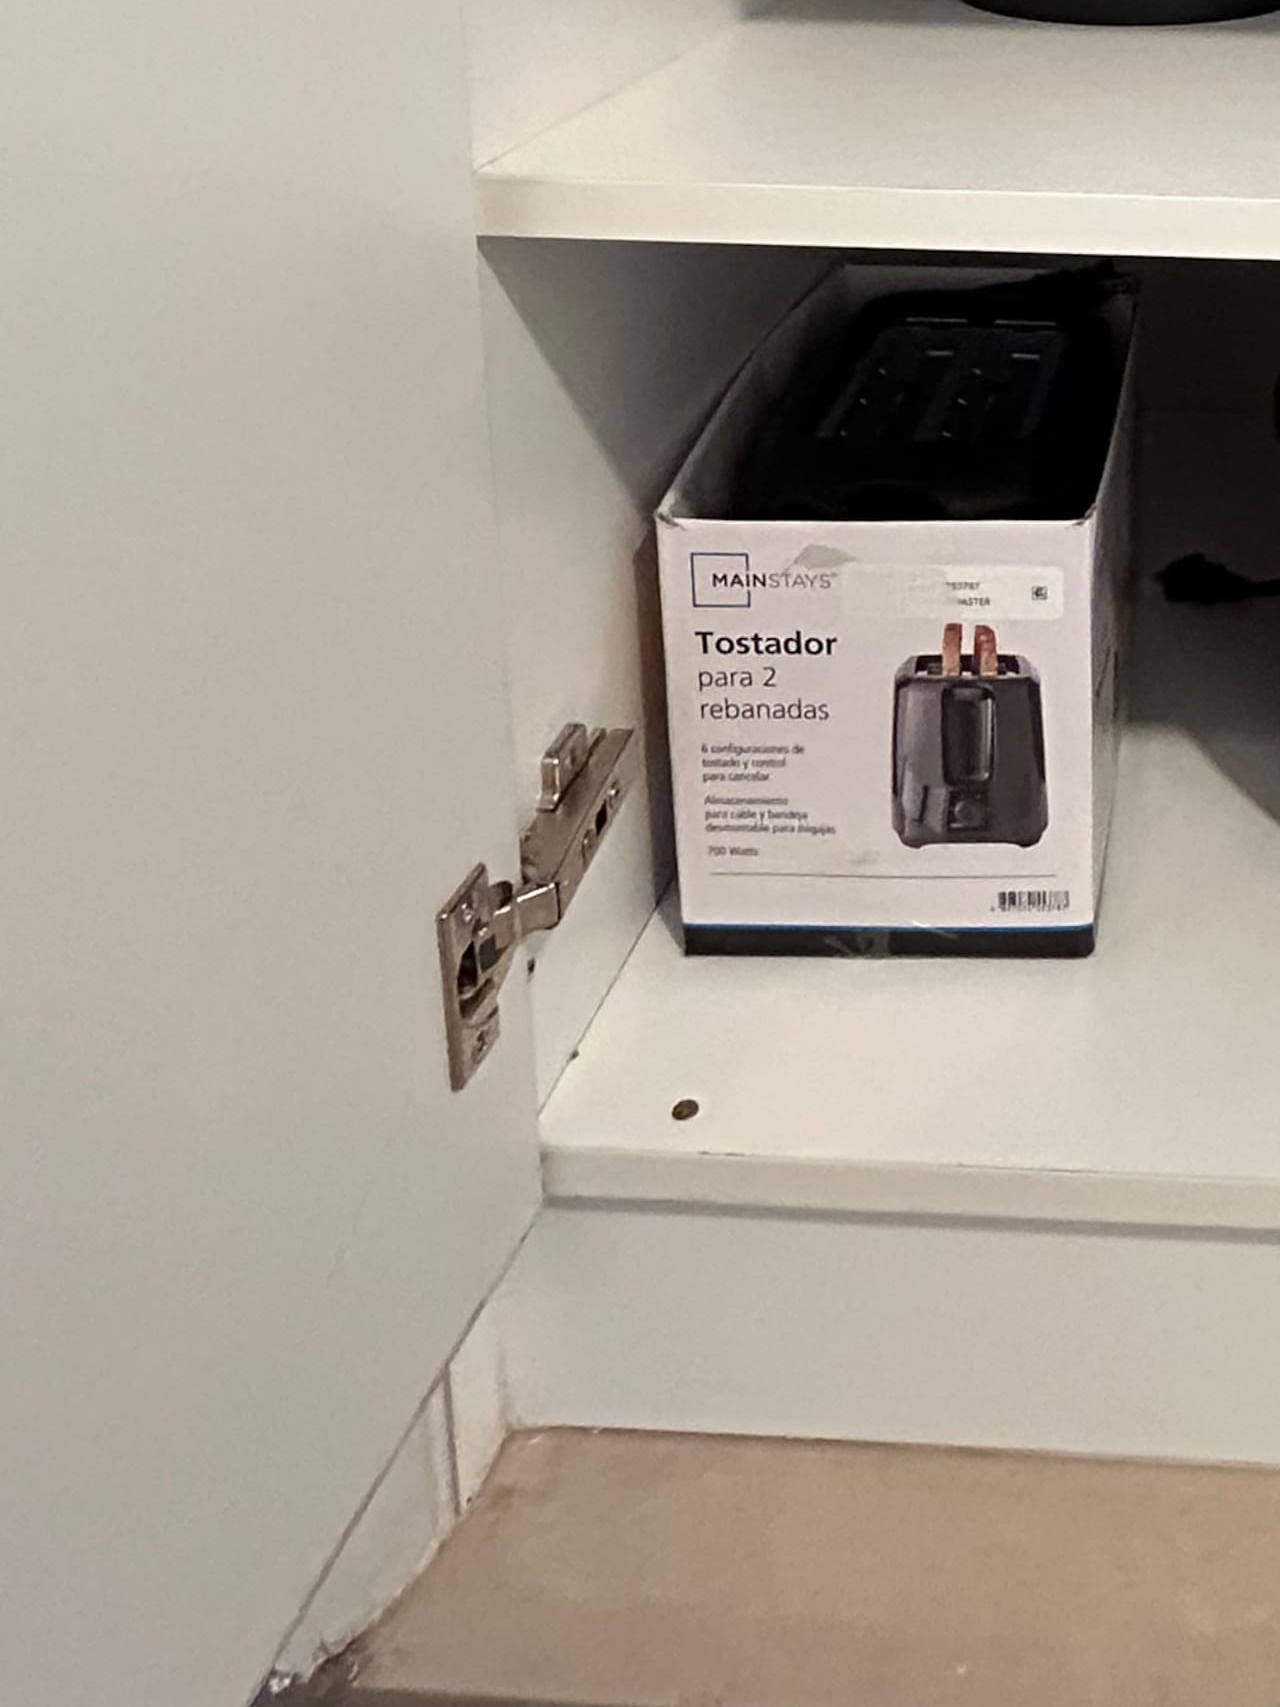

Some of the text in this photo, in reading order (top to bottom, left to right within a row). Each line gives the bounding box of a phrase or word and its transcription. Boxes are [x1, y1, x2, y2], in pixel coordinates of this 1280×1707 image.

[711, 572, 832, 589] MAINSTAYS
[694, 630, 838, 656] Tostador
[698, 666, 777, 692] para 2
[700, 697, 830, 720] rebanadas
